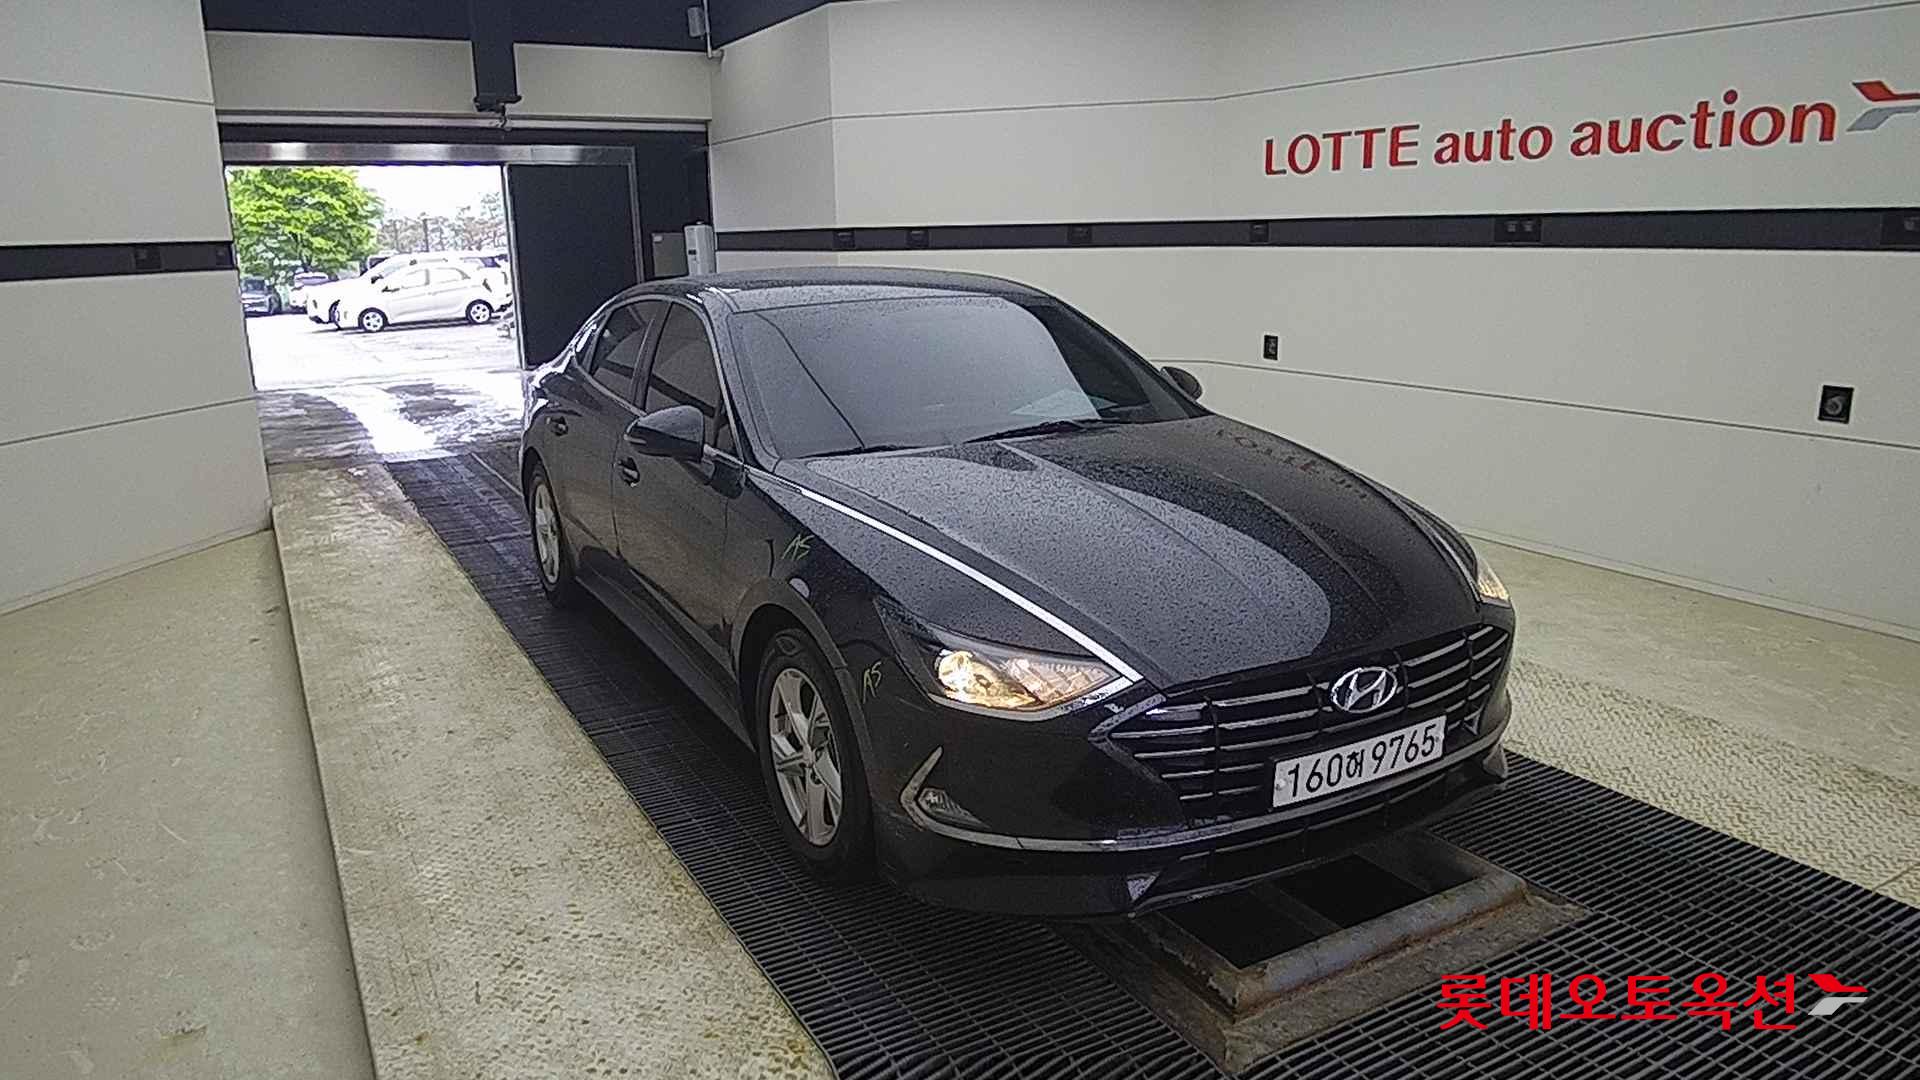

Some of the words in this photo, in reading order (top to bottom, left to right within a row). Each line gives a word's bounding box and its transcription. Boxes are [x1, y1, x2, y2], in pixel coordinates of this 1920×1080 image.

[1264, 124, 1420, 175] LOTTE
[1433, 118, 1553, 165] auto
[1570, 90, 1836, 156] auction
